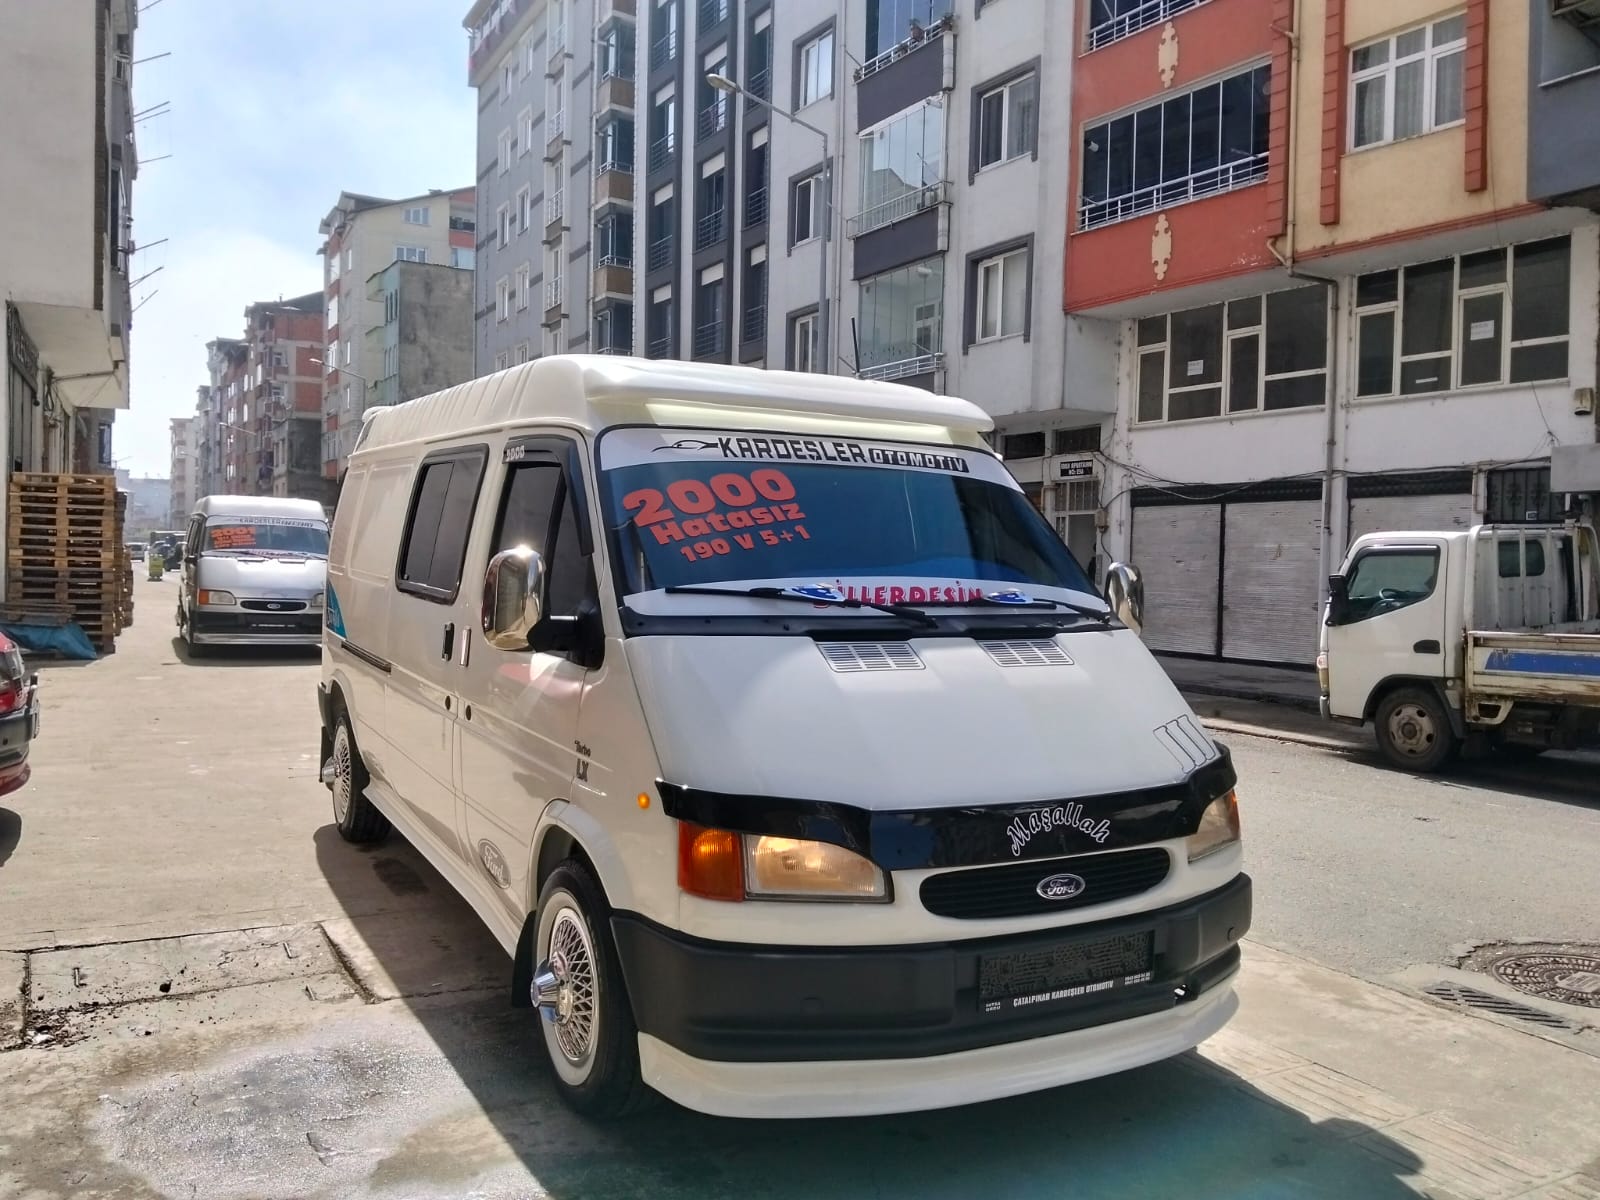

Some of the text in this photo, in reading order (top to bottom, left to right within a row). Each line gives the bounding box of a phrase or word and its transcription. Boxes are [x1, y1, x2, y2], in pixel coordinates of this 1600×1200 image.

[718, 436, 869, 464] KARDEŞLER
[622, 468, 797, 528] 2000
[649, 501, 807, 547] Hatasız
[680, 525, 811, 563] 190 V 5+1
[813, 578, 984, 609] İLLERDESİN
[576, 758, 589, 782] LX
[1006, 801, 1111, 857] Maşallah
